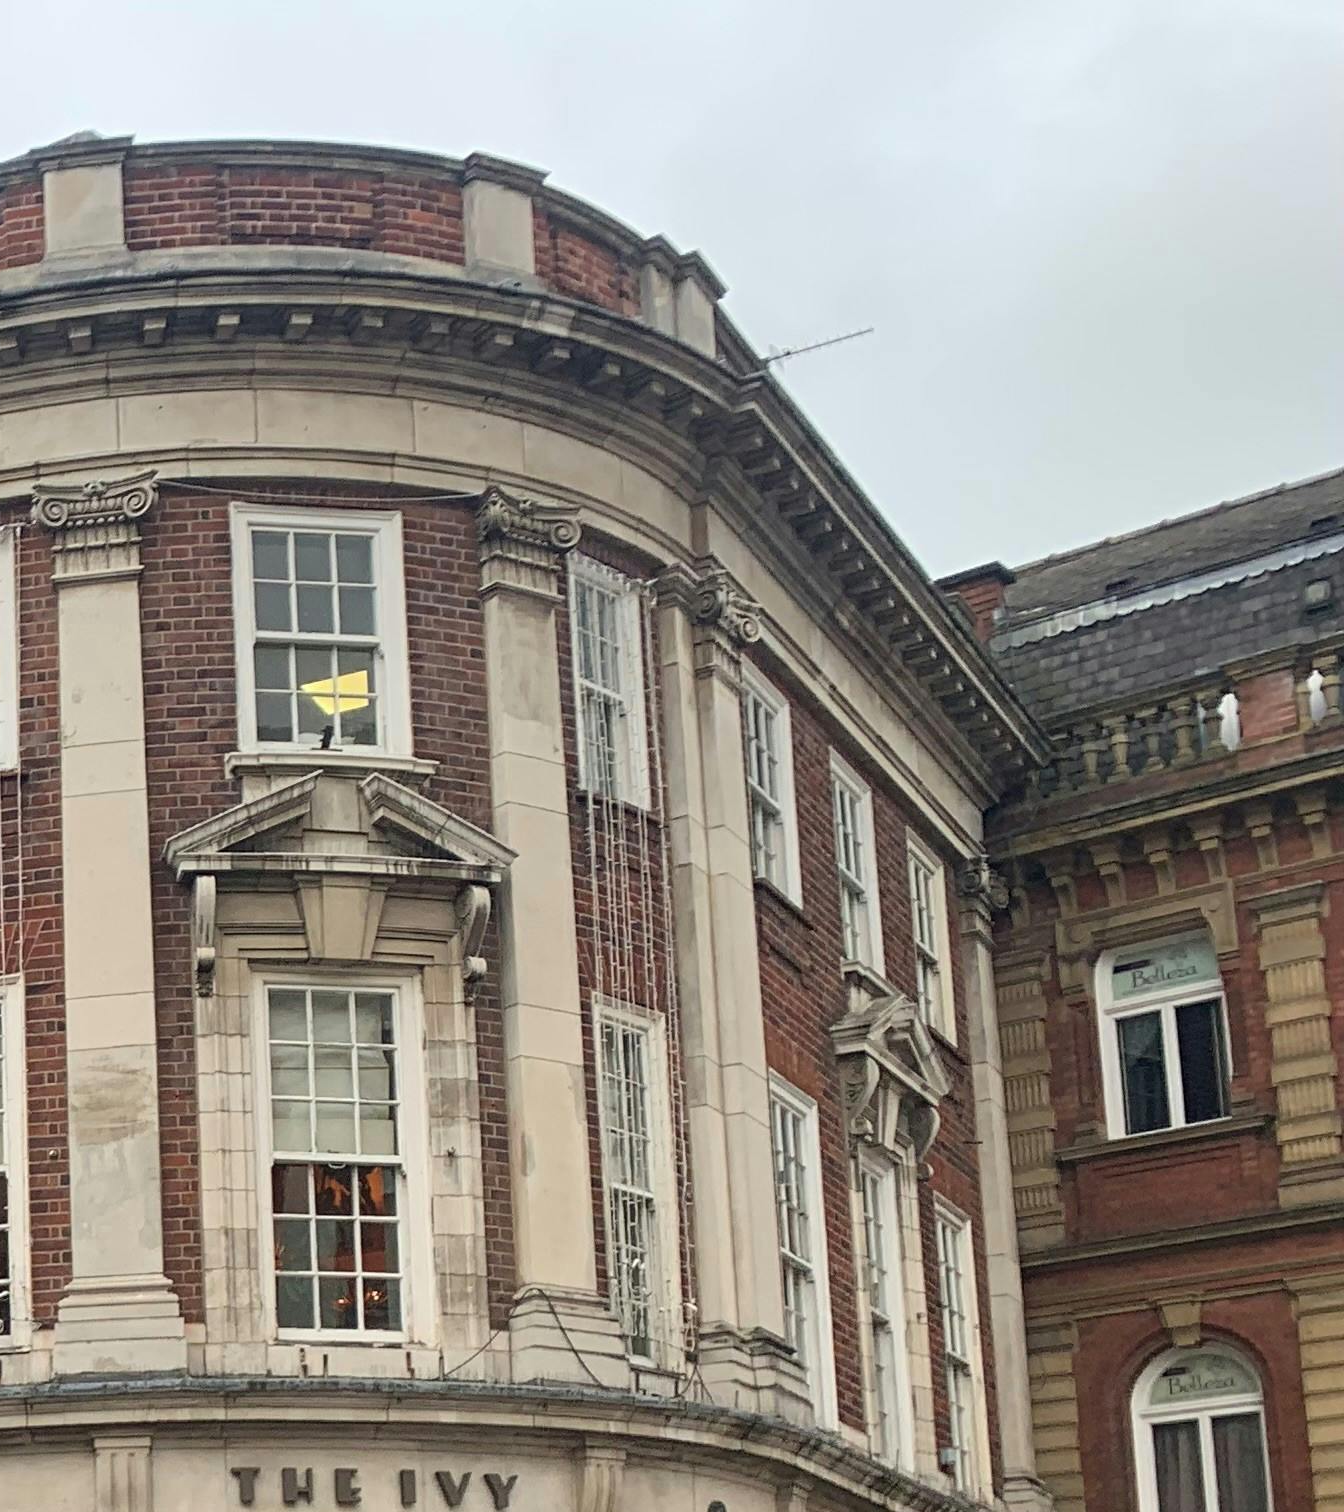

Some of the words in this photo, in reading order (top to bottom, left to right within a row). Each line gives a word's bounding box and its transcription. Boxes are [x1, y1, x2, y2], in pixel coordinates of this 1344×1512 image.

[1130, 964, 1198, 989] Belleza
[230, 1466, 362, 1507] THE
[399, 1468, 519, 1512] IVY
